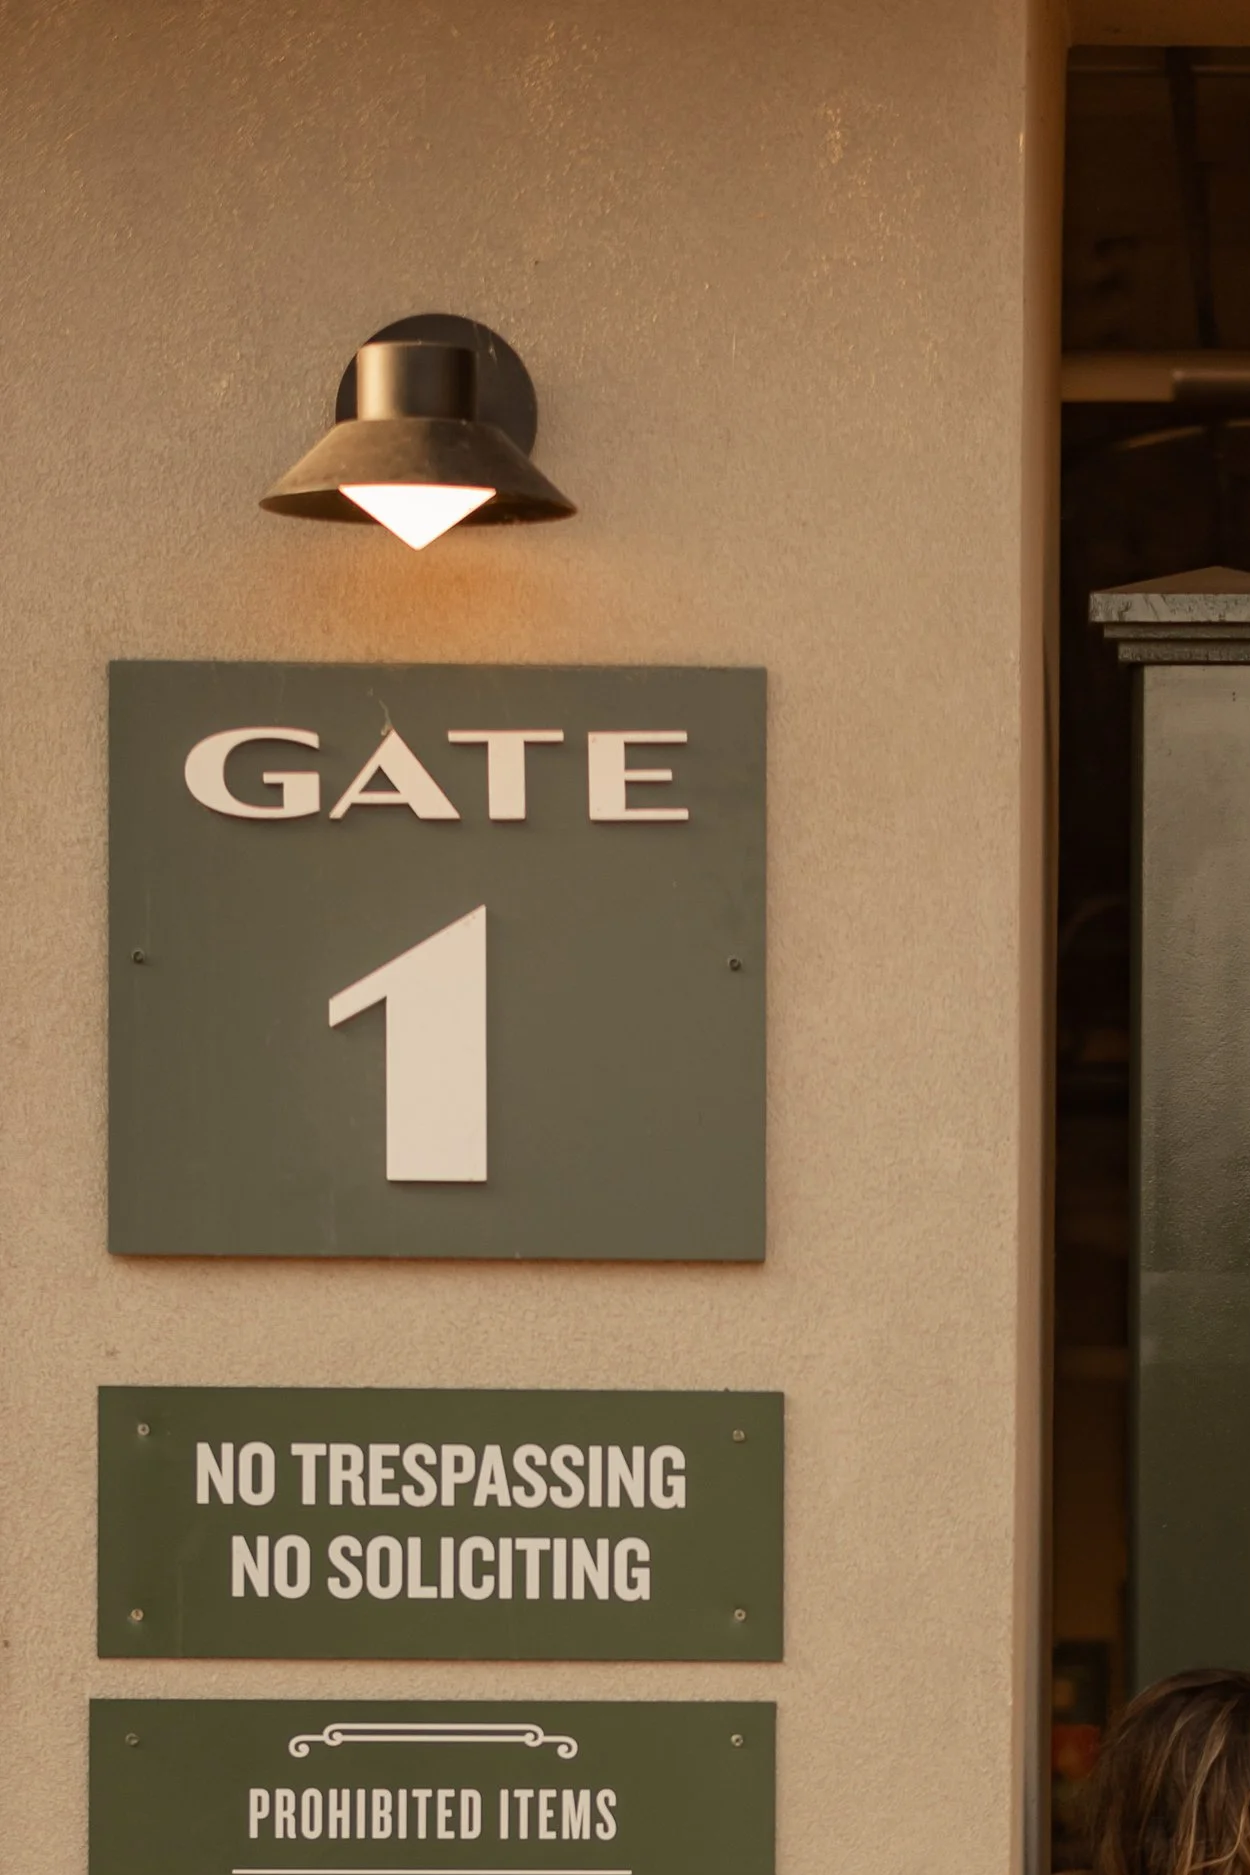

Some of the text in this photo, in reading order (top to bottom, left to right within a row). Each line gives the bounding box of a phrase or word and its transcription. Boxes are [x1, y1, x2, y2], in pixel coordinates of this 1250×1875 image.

[185, 726, 688, 820] GATE
[329, 905, 486, 1181] 1
[197, 1442, 685, 1509] NO TRESPASSING
[232, 1535, 650, 1601] NO SOLICITING
[250, 1788, 616, 1840] PROHIBITED ITEMS
